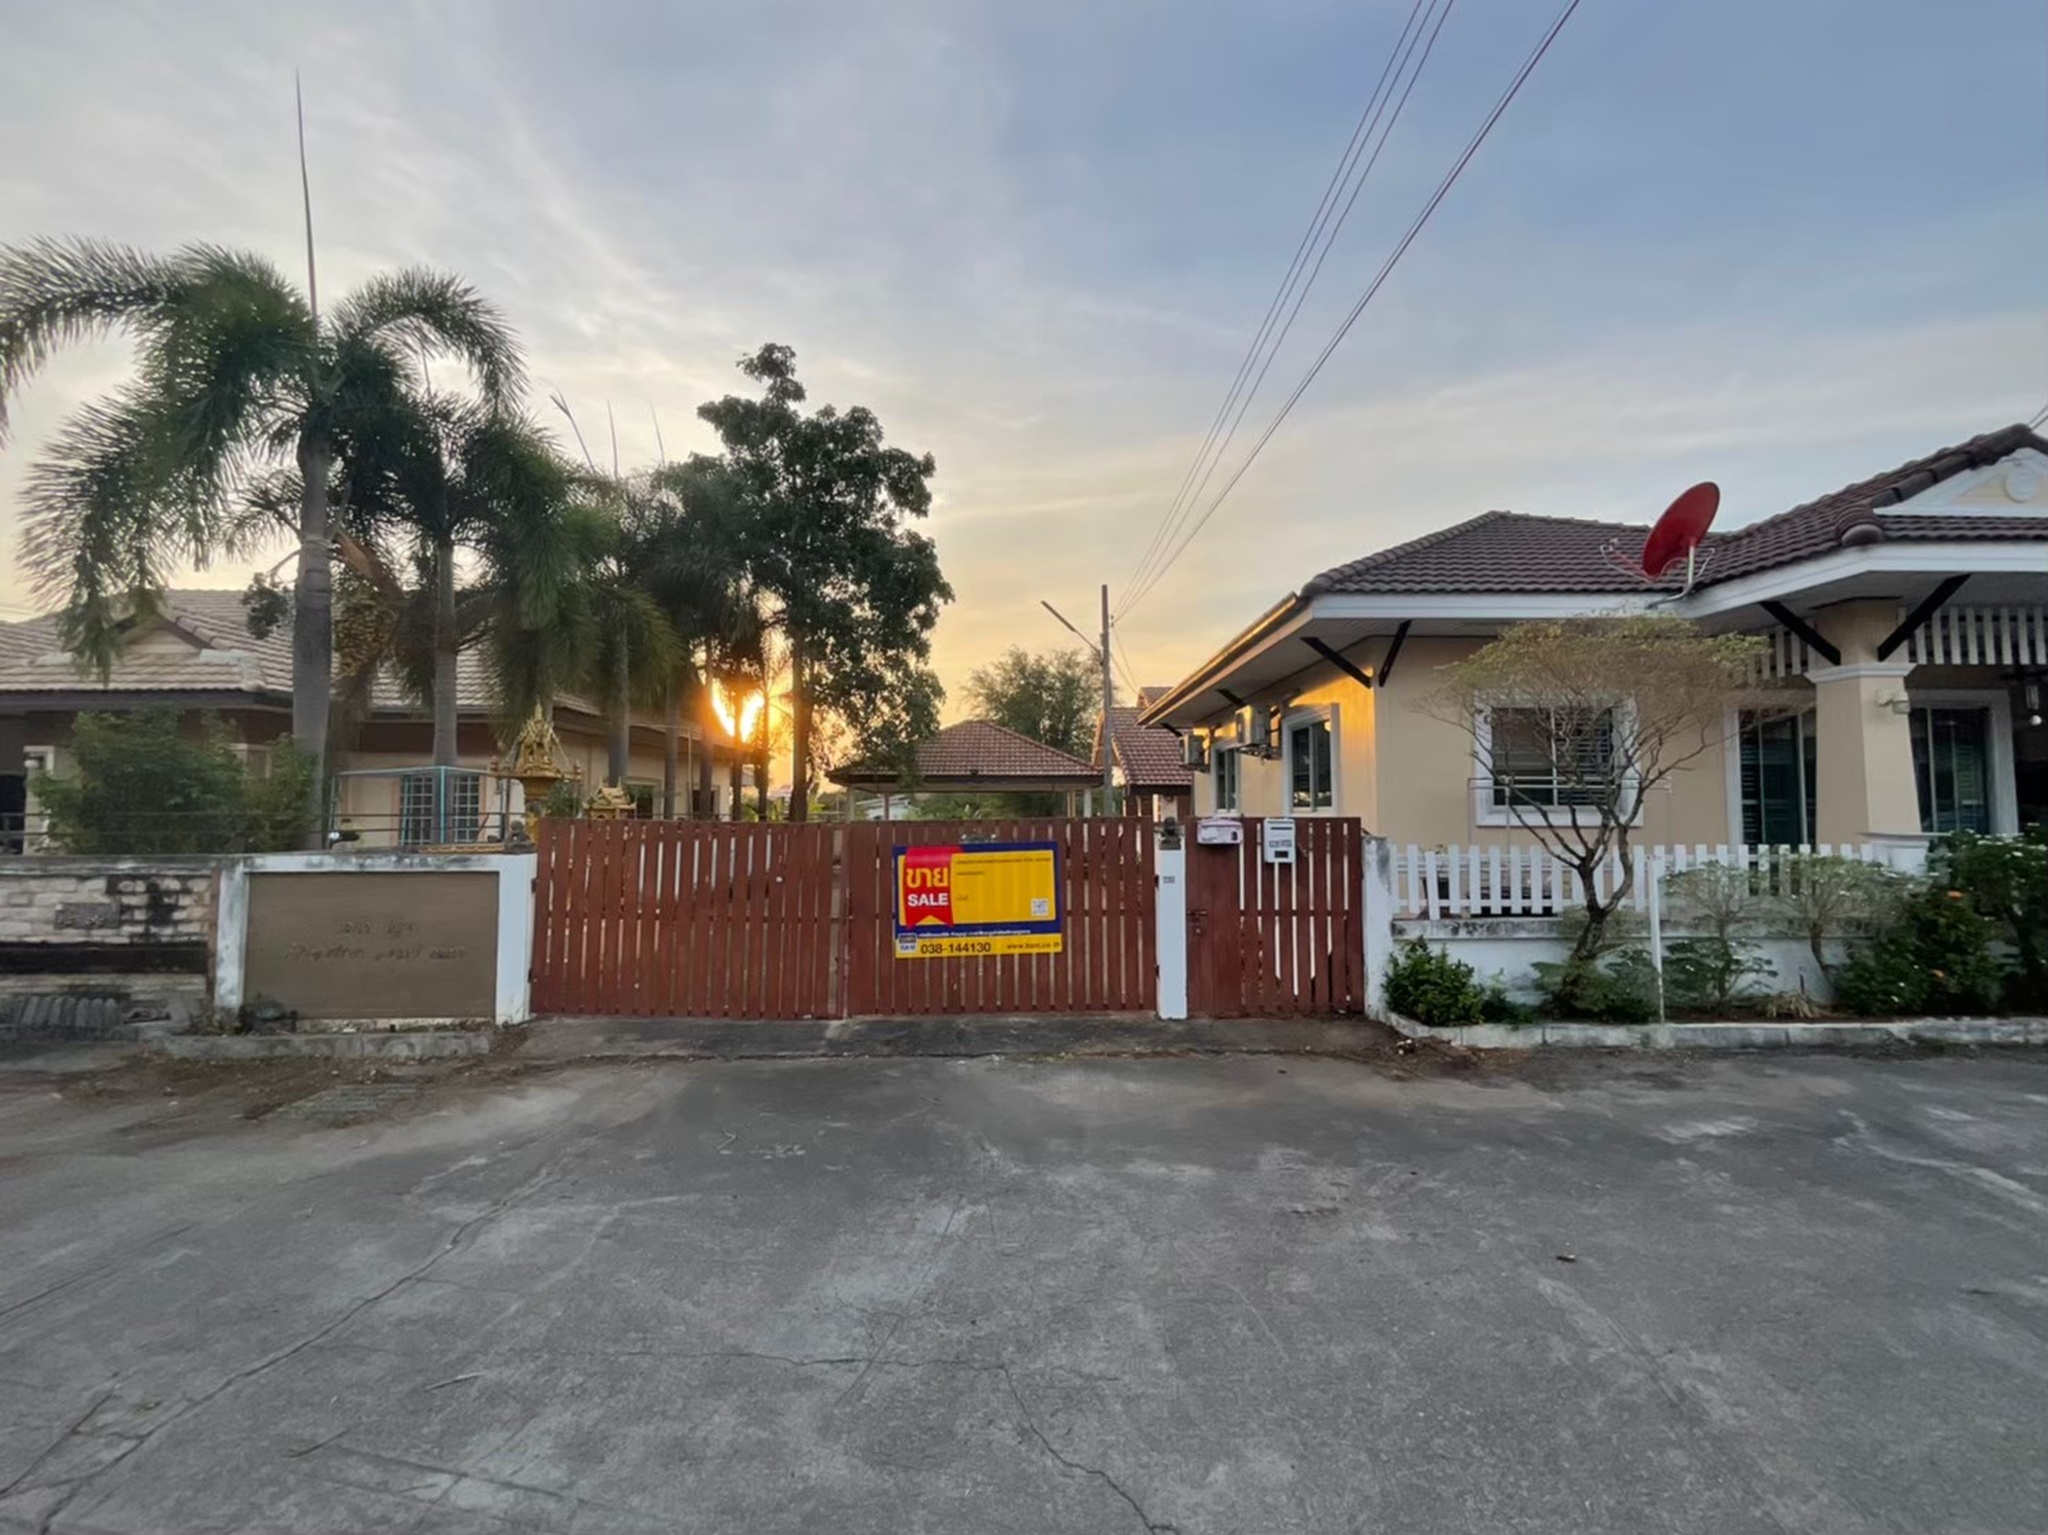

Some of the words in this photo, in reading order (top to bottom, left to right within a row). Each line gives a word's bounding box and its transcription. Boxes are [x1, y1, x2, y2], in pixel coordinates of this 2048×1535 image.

[906, 867, 949, 888] ขาย
[907, 893, 949, 907] SALE
[920, 942, 991, 954] 038-144130
